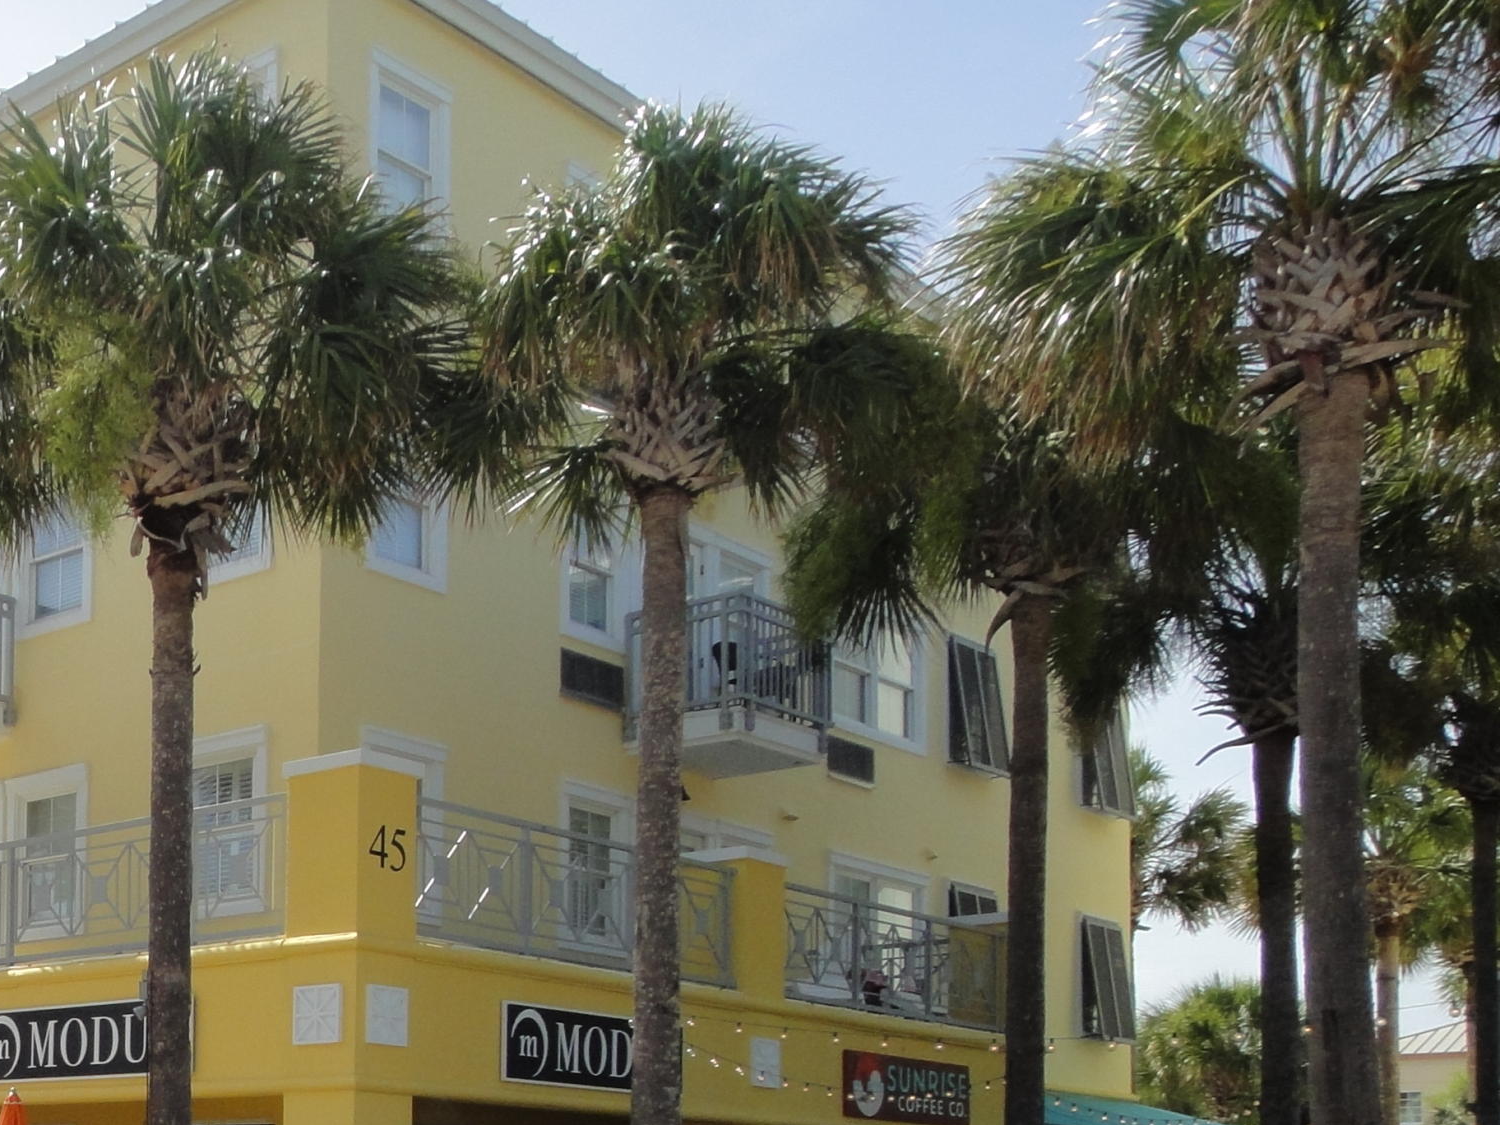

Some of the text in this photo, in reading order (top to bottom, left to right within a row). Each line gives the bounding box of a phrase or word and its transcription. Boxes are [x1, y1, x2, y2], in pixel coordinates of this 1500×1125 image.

[368, 824, 406, 872] 45
[26, 1013, 148, 1069] MODU
[555, 1021, 634, 1078] MOD
[886, 1064, 967, 1100] SUNRISE
[897, 1096, 968, 1118] COFFEE CO.
